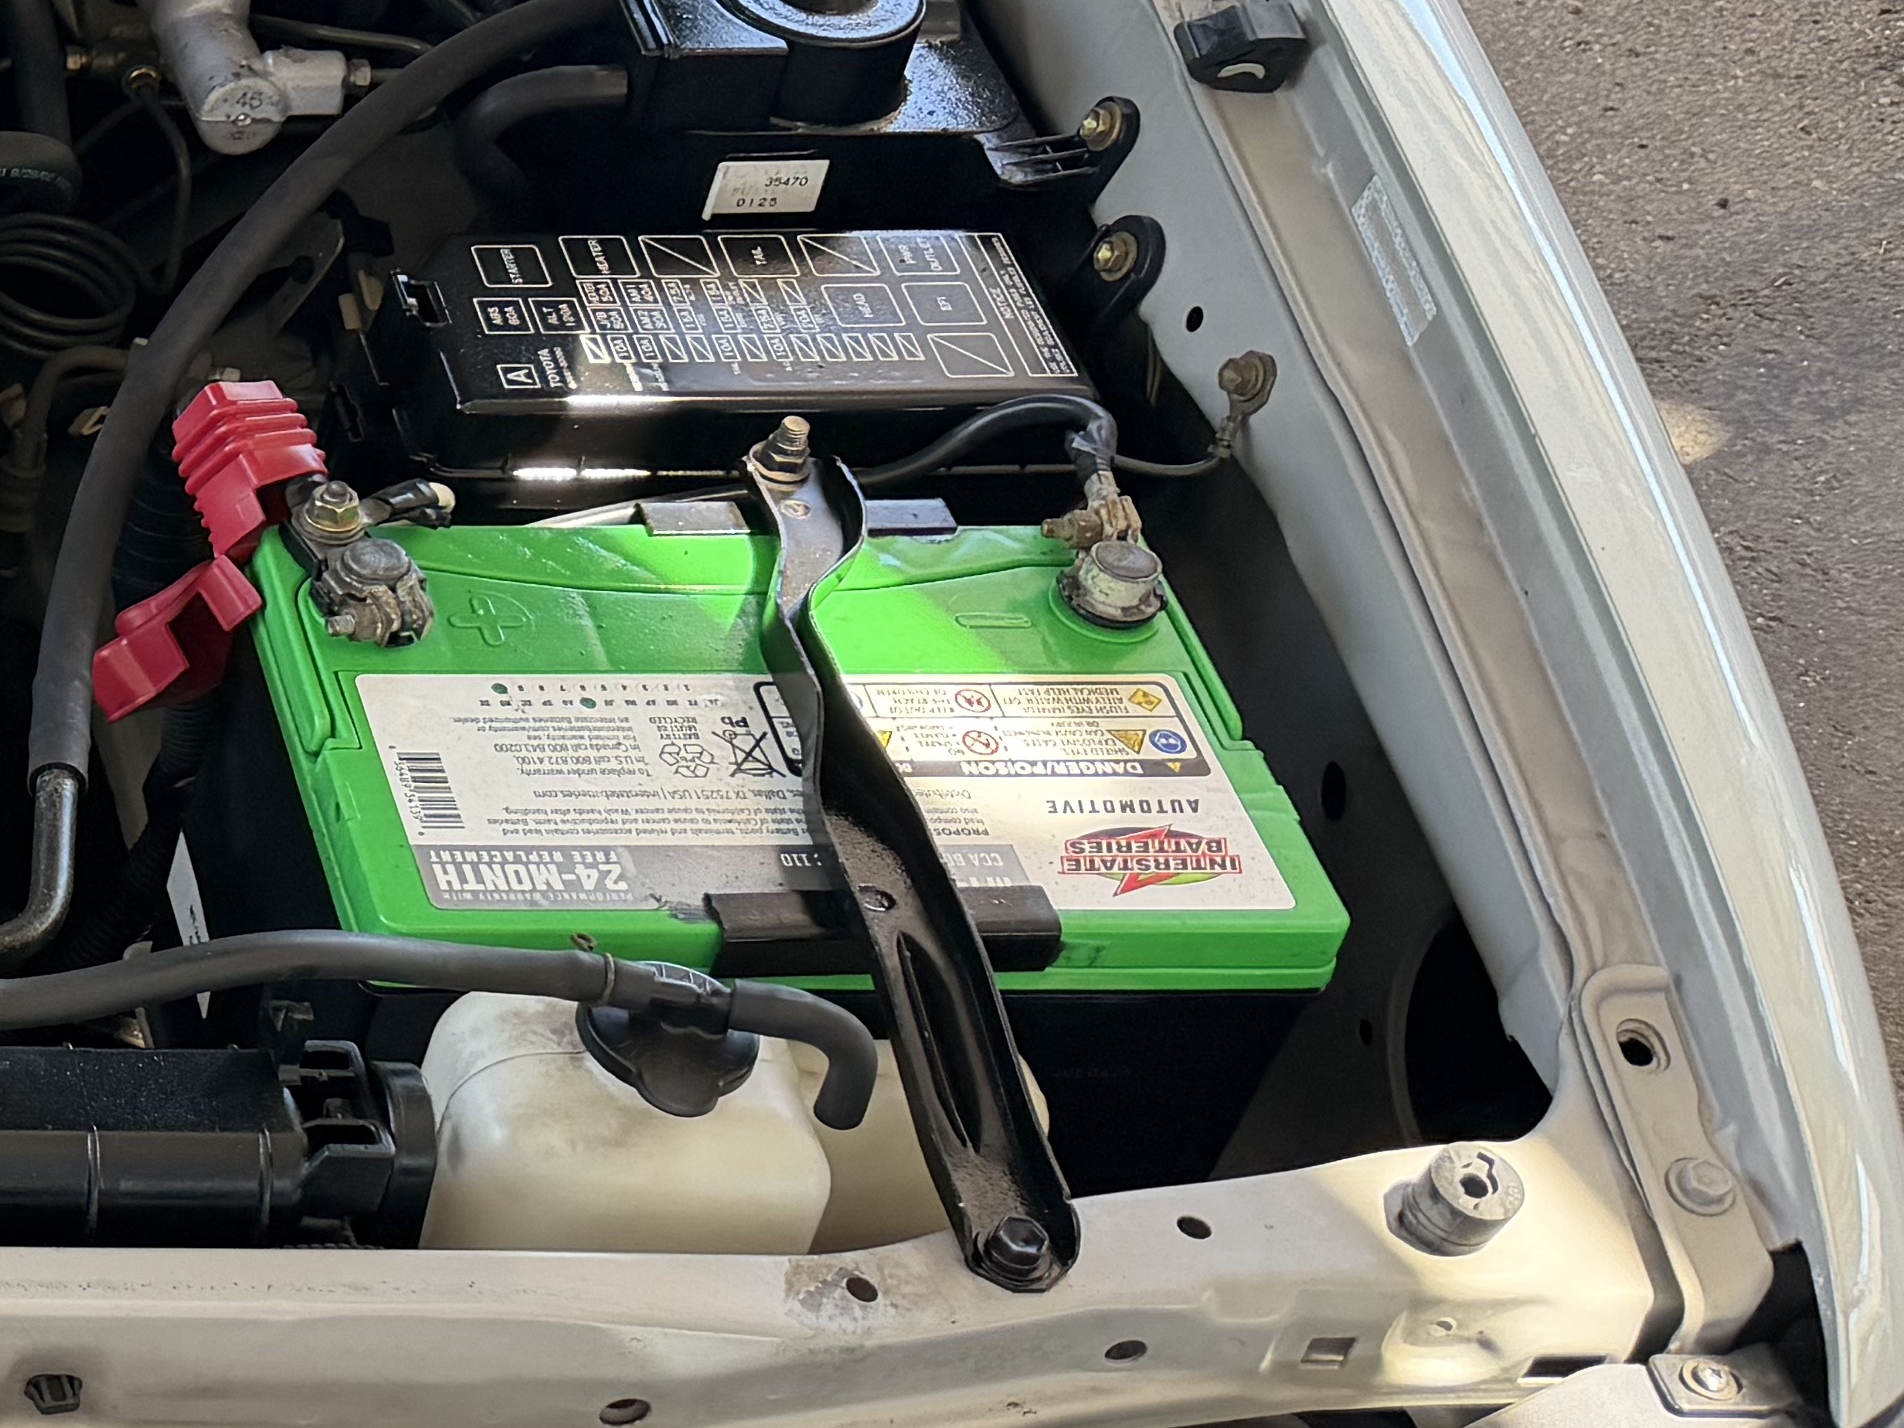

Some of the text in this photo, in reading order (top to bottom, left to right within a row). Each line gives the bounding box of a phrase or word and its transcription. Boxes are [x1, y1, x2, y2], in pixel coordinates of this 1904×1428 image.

[765, 177, 808, 187] 35470
[589, 239, 611, 274] HEATER
[755, 246, 767, 265] TAIL
[917, 237, 942, 271] OUTLET
[500, 248, 522, 284] STARTER
[853, 293, 872, 318] HEAD
[937, 295, 952, 311] EFI
[989, 287, 1014, 319] NOTICE
[543, 308, 558, 324] ALT
[538, 349, 561, 388] TOYOTA
[507, 369, 533, 383] A
[721, 716, 748, 728] Pb
[960, 762, 1143, 774] DANGER/POISON
[667, 790, 692, 800] USA
[694, 790, 730, 800] 75251
[733, 790, 748, 800] TX
[748, 790, 786, 800] Dallas,
[1046, 799, 1199, 813] AUTOMOTIVE
[1067, 840, 1223, 854] BATTERIES
[430, 850, 617, 862] FREE REPLACEMENT
[780, 853, 1003, 866] CCA 110
[1065, 857, 1238, 871] INTERSTATE
[431, 863, 628, 890] 24-MONTH
